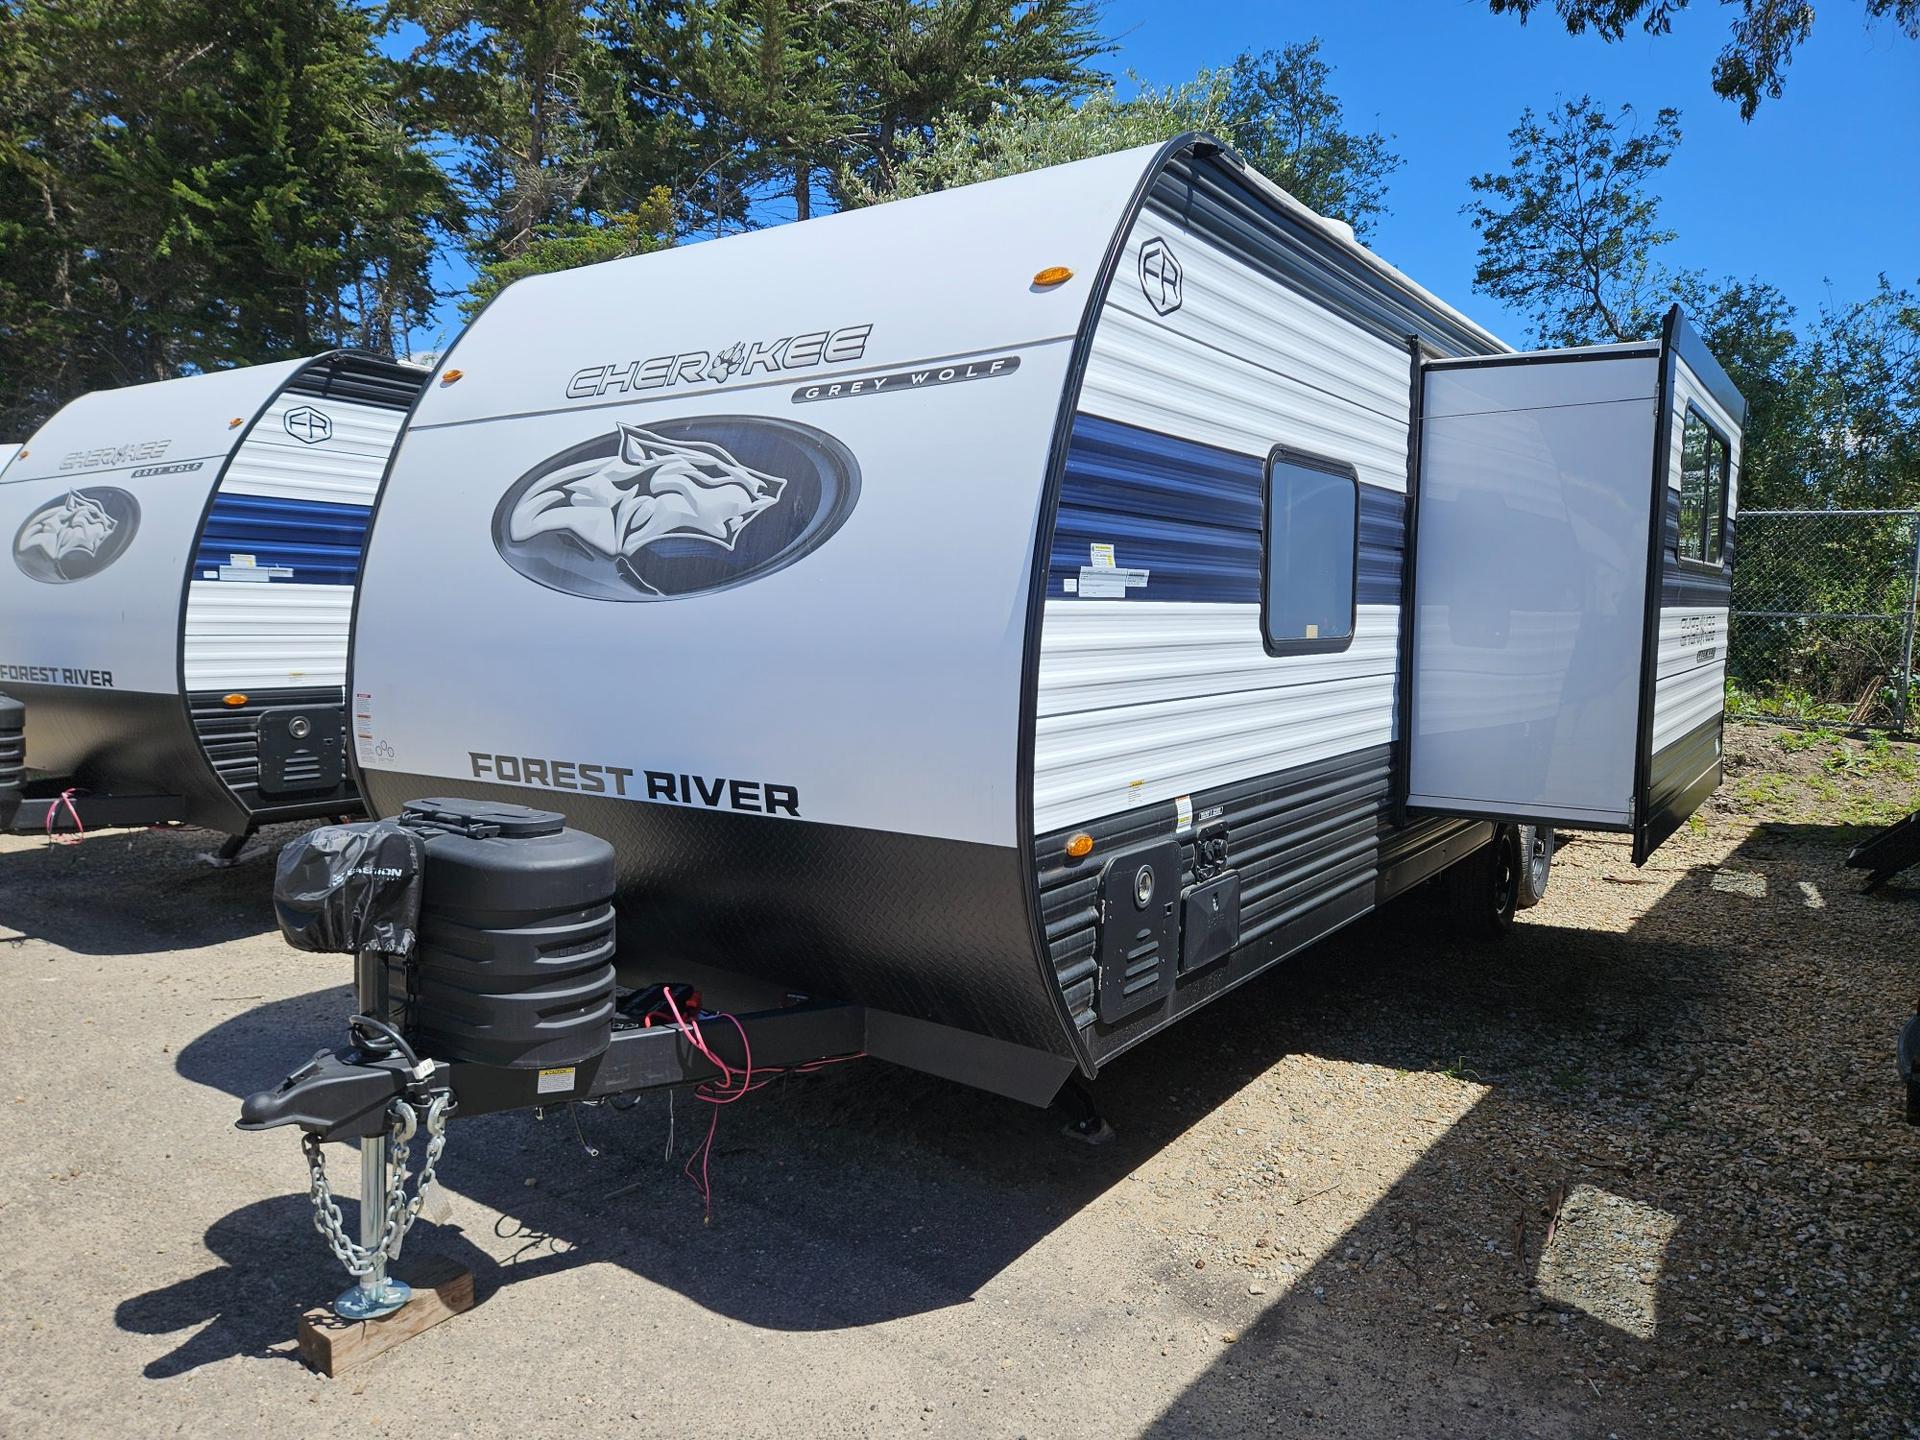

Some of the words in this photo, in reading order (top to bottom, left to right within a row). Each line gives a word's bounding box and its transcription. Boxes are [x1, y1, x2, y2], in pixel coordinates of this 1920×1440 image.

[805, 378, 887, 399] GREY
[911, 360, 1004, 385] WOLF
[134, 468, 163, 477] GREY
[0, 664, 58, 683] FOREST
[62, 668, 114, 687] RIVER
[467, 751, 633, 795] FOREST
[643, 770, 801, 817] RIVER
